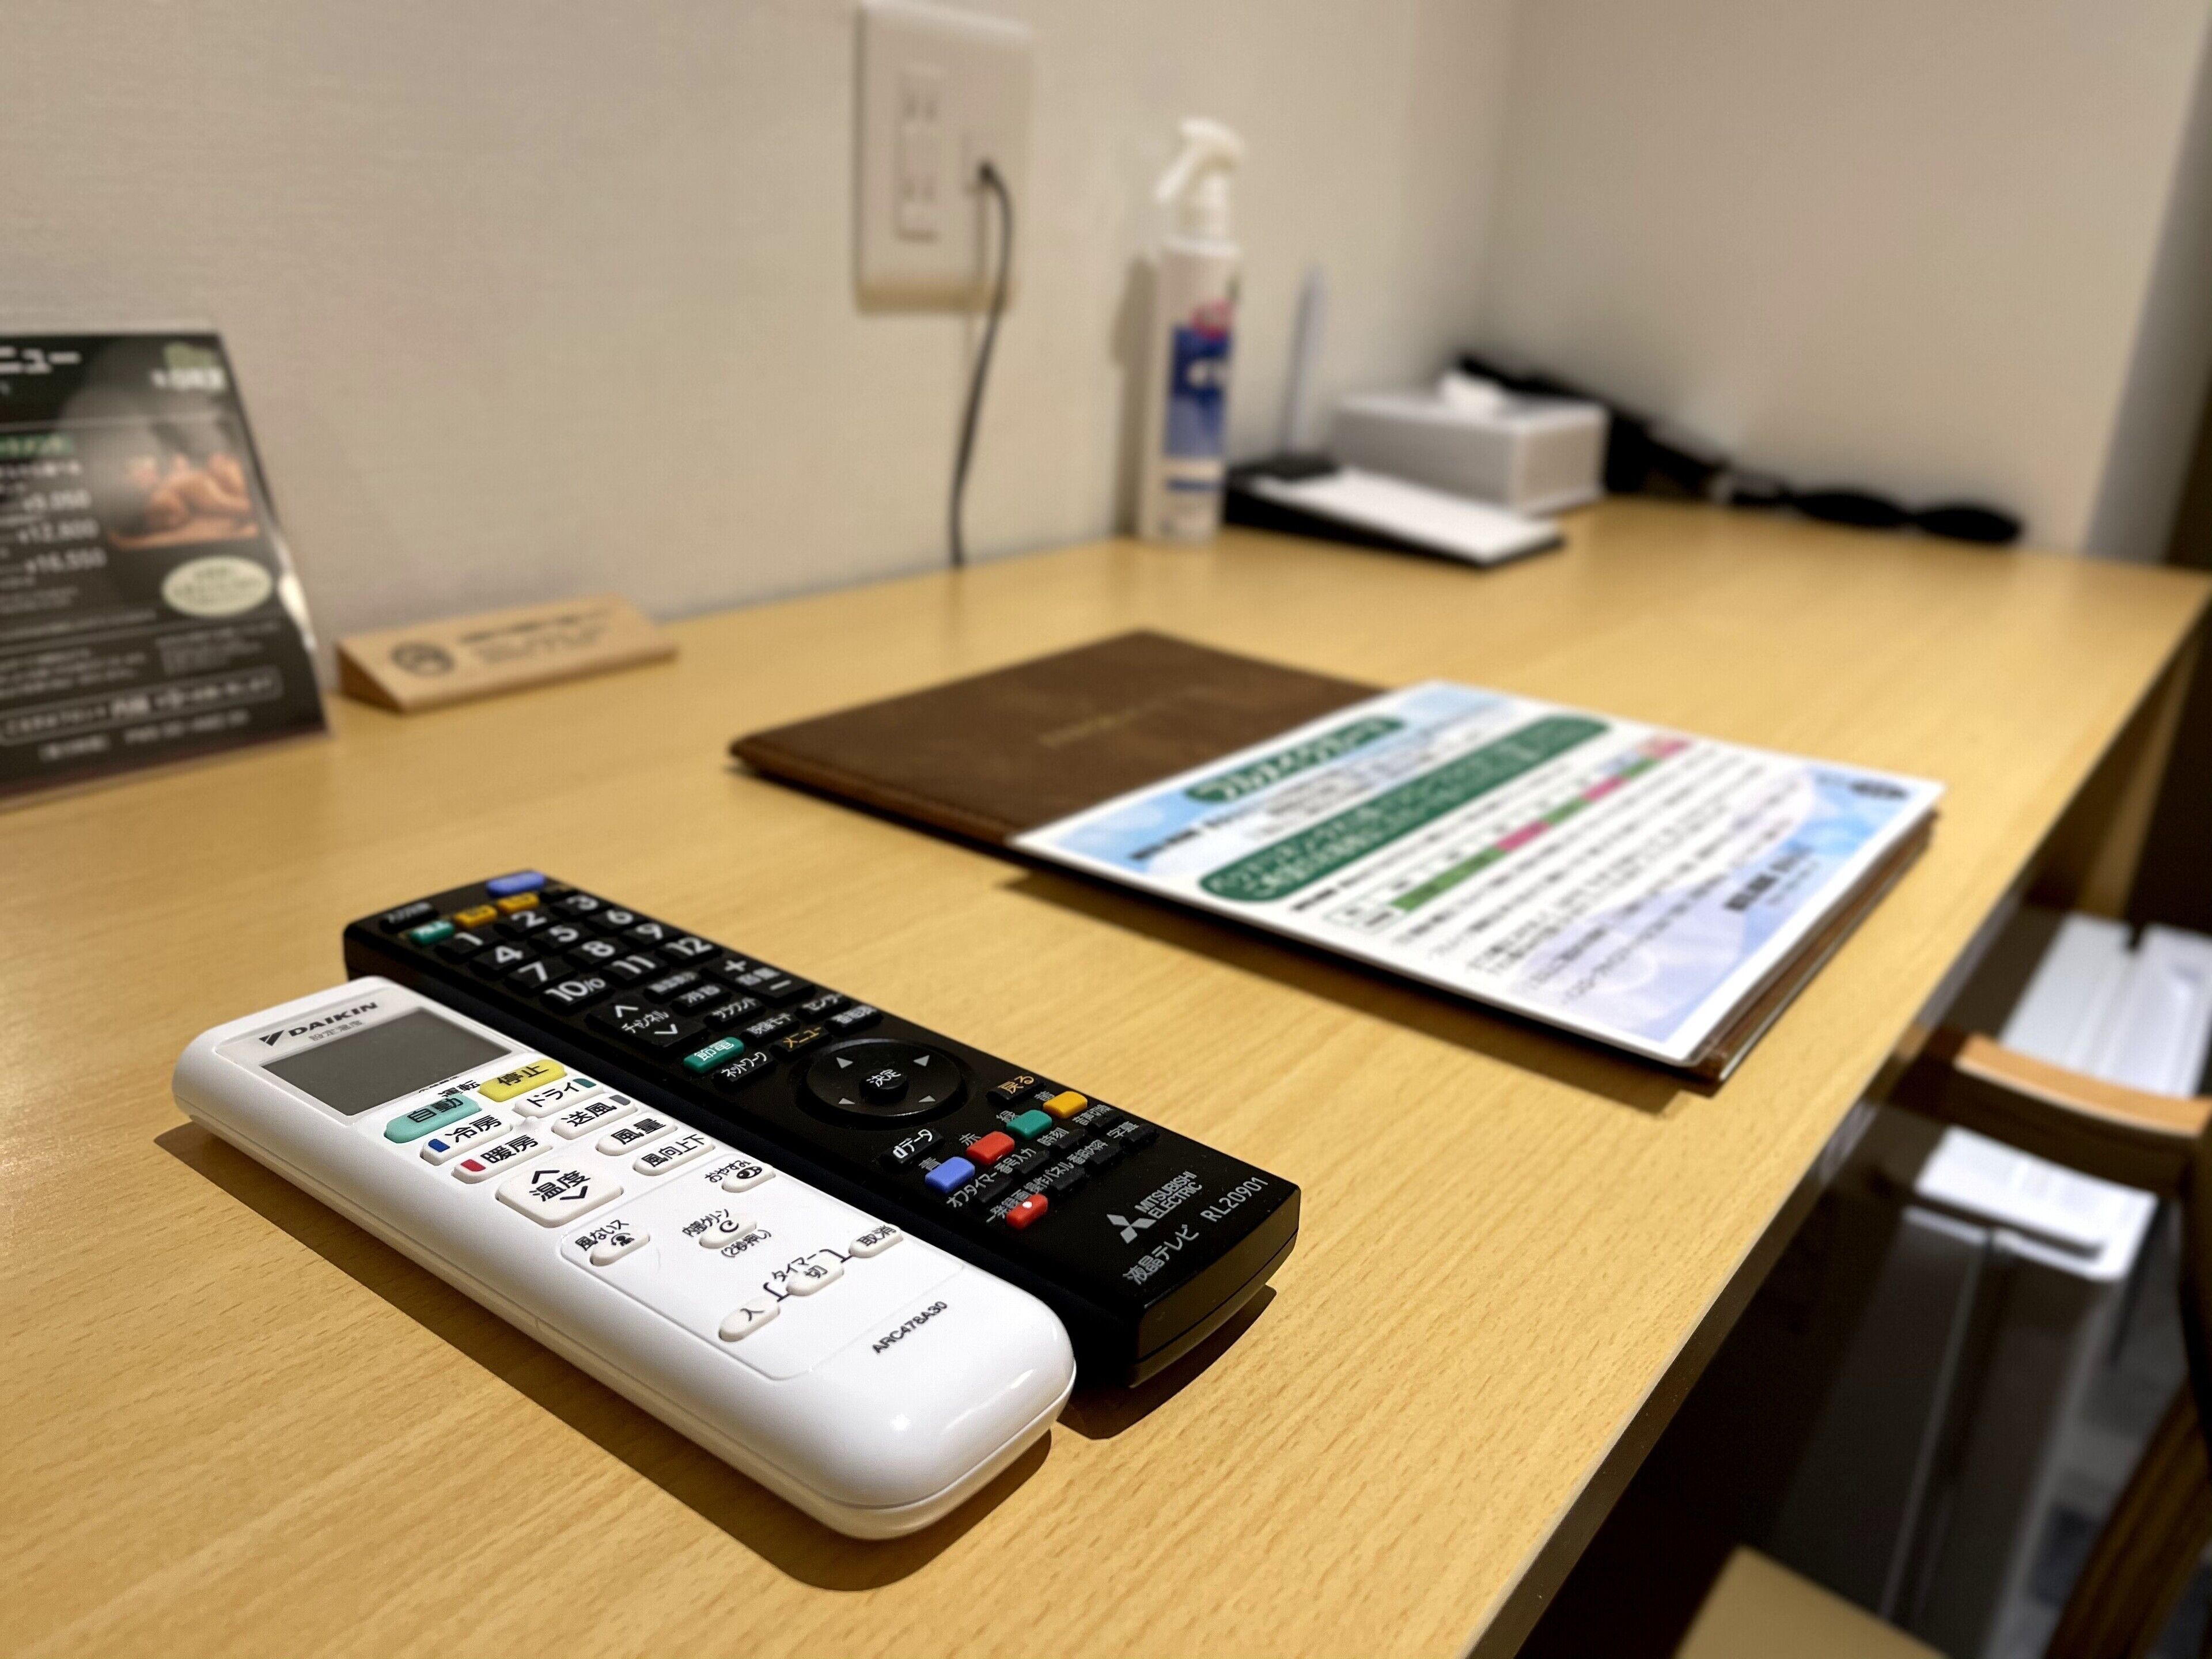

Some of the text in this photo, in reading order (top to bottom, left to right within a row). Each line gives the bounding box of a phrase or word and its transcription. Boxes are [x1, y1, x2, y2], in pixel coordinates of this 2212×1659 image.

[566, 893, 599, 912] 3
[512, 911, 546, 927] 2
[603, 908, 633, 925] 6
[454, 931, 483, 946] 1
[549, 925, 579, 943] 5
[635, 923, 664, 940] 9
[495, 944, 522, 965] 4
[581, 940, 615, 958] 8
[666, 937, 711, 956] 12
[516, 960, 548, 980] 7
[613, 955, 657, 975] 11
[288, 1002, 378, 1037] DAIKIN
[622, 1010, 669, 1033] チャンネル
[695, 1037, 734, 1061] 節電
[783, 1027, 821, 1048] メニュー
[497, 1063, 549, 1087] 停止
[722, 1051, 766, 1078] ネットワーク
[438, 1080, 480, 1099] 運転
[866, 1069, 901, 1088] 決定
[998, 1075, 1034, 1094] 戻る
[526, 1080, 582, 1109] ドライ
[406, 1095, 464, 1123] 自動
[560, 1101, 617, 1127] 送風
[445, 1116, 502, 1143] 冷房
[611, 1118, 666, 1145] 風量
[959, 1132, 982, 1147] 赤
[1037, 1127, 1069, 1146] 時刻
[481, 1134, 539, 1164] 暖房
[641, 1134, 705, 1168] 風向上下
[1067, 1139, 1108, 1164] 番組内容
[704, 1160, 751, 1183] おやすみ
[919, 1156, 941, 1172] 青
[994, 1148, 1036, 1174] 番号入力
[529, 1170, 590, 1203] 温度
[1024, 1161, 1074, 1194] 操作パネル
[946, 1172, 997, 1207] オフタイマー
[1134, 1171, 1196, 1213] MITSUBISHI
[1148, 1181, 1202, 1220] ELECTRIC
[575, 1219, 629, 1251] 風ないス
[856, 1225, 897, 1247] 取消
[1122, 1176, 1268, 1285] 液晶テレビ RL20901
[772, 1253, 817, 1282] タイマー
[803, 1265, 828, 1278] 切
[872, 1301, 949, 1354] ARC478A30
